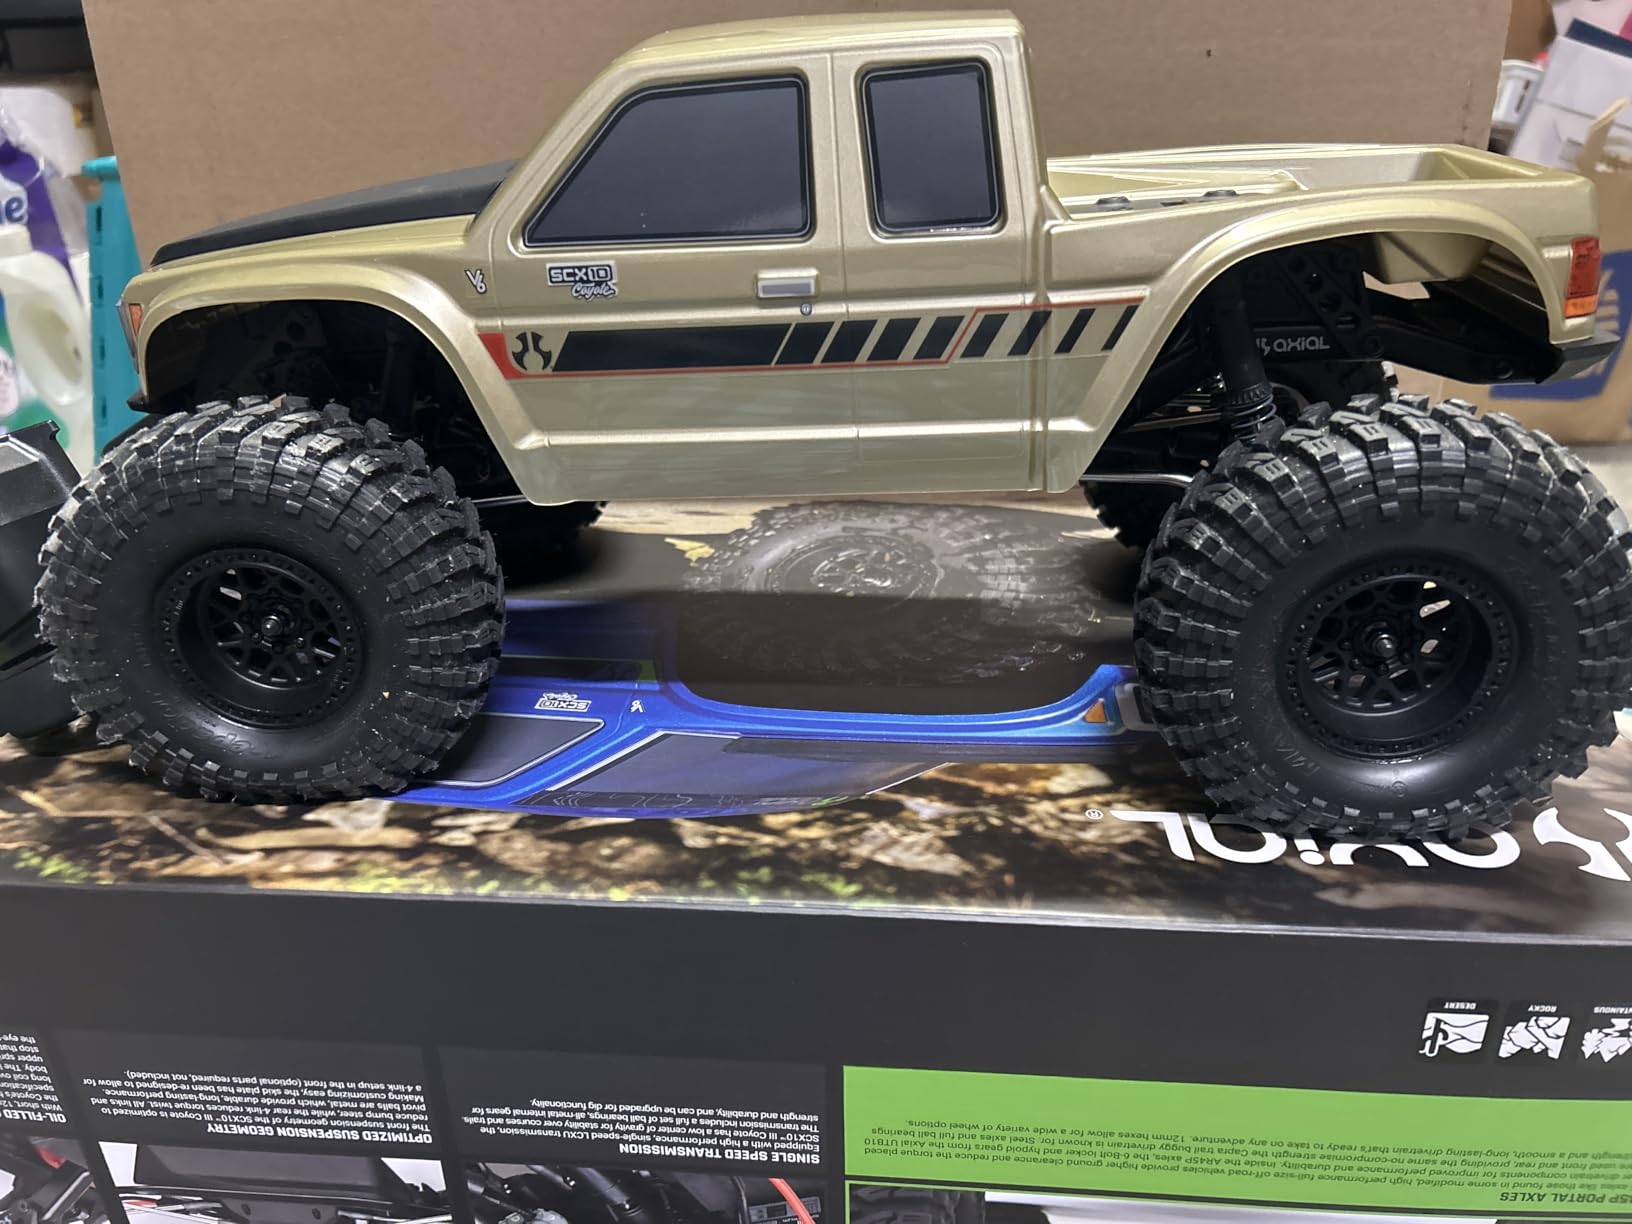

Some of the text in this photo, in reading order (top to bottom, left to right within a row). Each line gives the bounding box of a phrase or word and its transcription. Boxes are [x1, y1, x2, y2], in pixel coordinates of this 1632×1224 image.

[549, 264, 613, 285] SCX10
[464, 269, 487, 294] V6
[571, 282, 618, 300] Coyote
[1444, 1002, 1476, 1010] DESERT
[1528, 1005, 1557, 1013] ROCKY
[171, 1073, 188, 1081] not
[231, 1076, 258, 1084] parts
[83, 1078, 97, 1087] for
[98, 1079, 123, 1088] allow
[135, 1080, 190, 1091] re-designed
[259, 1078, 302, 1088] (optional
[303, 1080, 328, 1089] front
[329, 1081, 346, 1089] the
[346, 1082, 356, 1090] in
[357, 1081, 386, 1090] setup
[191, 1084, 216, 1094] been
[216, 1086, 236, 1094] has
[236, 1086, 261, 1096] plate
[261, 1088, 282, 1097] skid
[284, 1089, 300, 1097] the
[387, 1084, 414, 1093] 4-link
[165, 1091, 221, 1103] long-lasting
[327, 1088, 387, 1100] customizing
[388, 1091, 425, 1103] Making
[90, 1097, 109, 1105] and
[109, 1099, 133, 1108] links
[132, 1100, 145, 1108] All
[260, 1097, 296, 1106] provide
[297, 1099, 327, 1108] which
[174, 1102, 205, 1111] torque
[205, 1104, 244, 1113] reduces
[244, 1106, 271, 1115] 4-link
[376, 1102, 401, 1112] balls
[402, 1103, 427, 1113] pivot
[588, 1101, 603, 1111] dig
[604, 1103, 618, 1113] for
[618, 1104, 663, 1113] upgraded
[2, 1108, 66, 1123] OIL-FILLED
[101, 1107, 112, 1115] to
[112, 1108, 158, 1117] optimized
[159, 1111, 169, 1119] is
[273, 1107, 292, 1115] rear
[293, 1108, 310, 1117] the
[310, 1109, 337, 1118] while
[365, 1109, 394, 1121] bump
[471, 1107, 485, 1116] for
[485, 1107, 512, 1115] gears
[512, 1109, 547, 1118] internal
[547, 1110, 586, 1120] all-metal
[664, 1107, 677, 1116] be
[677, 1107, 695, 1115] can
[696, 1108, 715, 1117] and
[169, 1111, 203, 1121] Coyote
[203, 1113, 214, 1121] III
[254, 1116, 271, 1124] the
[395, 1113, 429, 1122] reduce
[630, 1115, 647, 1124] ball
[648, 1116, 659, 1124] of
[659, 1116, 674, 1124] set
[760, 1112, 779, 1120] and
[780, 1112, 819, 1122] strength
[272, 1117, 282, 1125] of
[284, 1116, 329, 1126] geometry
[330, 1120, 385, 1128] suspension
[486, 1117, 505, 1126] and
[505, 1118, 542, 1126] courses
[564, 1119, 599, 1130] stability
[675, 1117, 690, 1126] full
[699, 1118, 738, 1128] includes
[386, 1122, 410, 1131] front
[411, 1123, 431, 1132] The
[480, 1126, 496, 1135] the
[600, 1123, 614, 1132] for
[614, 1122, 645, 1132] gravity
[646, 1125, 657, 1134] of
[657, 1126, 687, 1134] center
[739, 1121, 800, 1131] transmission
[800, 1124, 820, 1133] The
[207, 1123, 433, 1144] OPTIMIZED SUSPENSION GEOMETRY
[563, 1131, 590, 1140] LCXU
[591, 1131, 652, 1142] single-speed
[688, 1127, 705, 1137] low
[714, 1129, 732, 1138] has
[732, 1129, 767, 1140] Coyote
[768, 1132, 778, 1141] III
[719, 1137, 741, 1148] high
[751, 1141, 772, 1149] with
[774, 1141, 820, 1153] Equipped
[619, 1143, 820, 1164] SINGLE SPEED TRANSMISSION
[864, 1147, 898, 1157] placed
[900, 1148, 933, 1159] torque
[935, 1151, 952, 1160] the
[954, 1152, 990, 1161] reduce
[991, 1155, 1011, 1163] and
[1013, 1156, 1064, 1166] clearance
[1066, 1159, 1104, 1167] ground
[1105, 1161, 1139, 1171] higher
[1140, 1163, 1180, 1172] provide
[1182, 1166, 1226, 1176] vehicles
[1227, 1169, 1271, 1179] off-road
[1273, 1171, 1316, 1182] full-size
[1317, 1174, 1387, 1185] performance
[1389, 1176, 1413, 1186] high
[1500, 1182, 1511, 1190] in
[1511, 1182, 1544, 1191] found
[1499, 1192, 1547, 1202] AXLES
[1551, 1193, 1607, 1204] PORTAL
